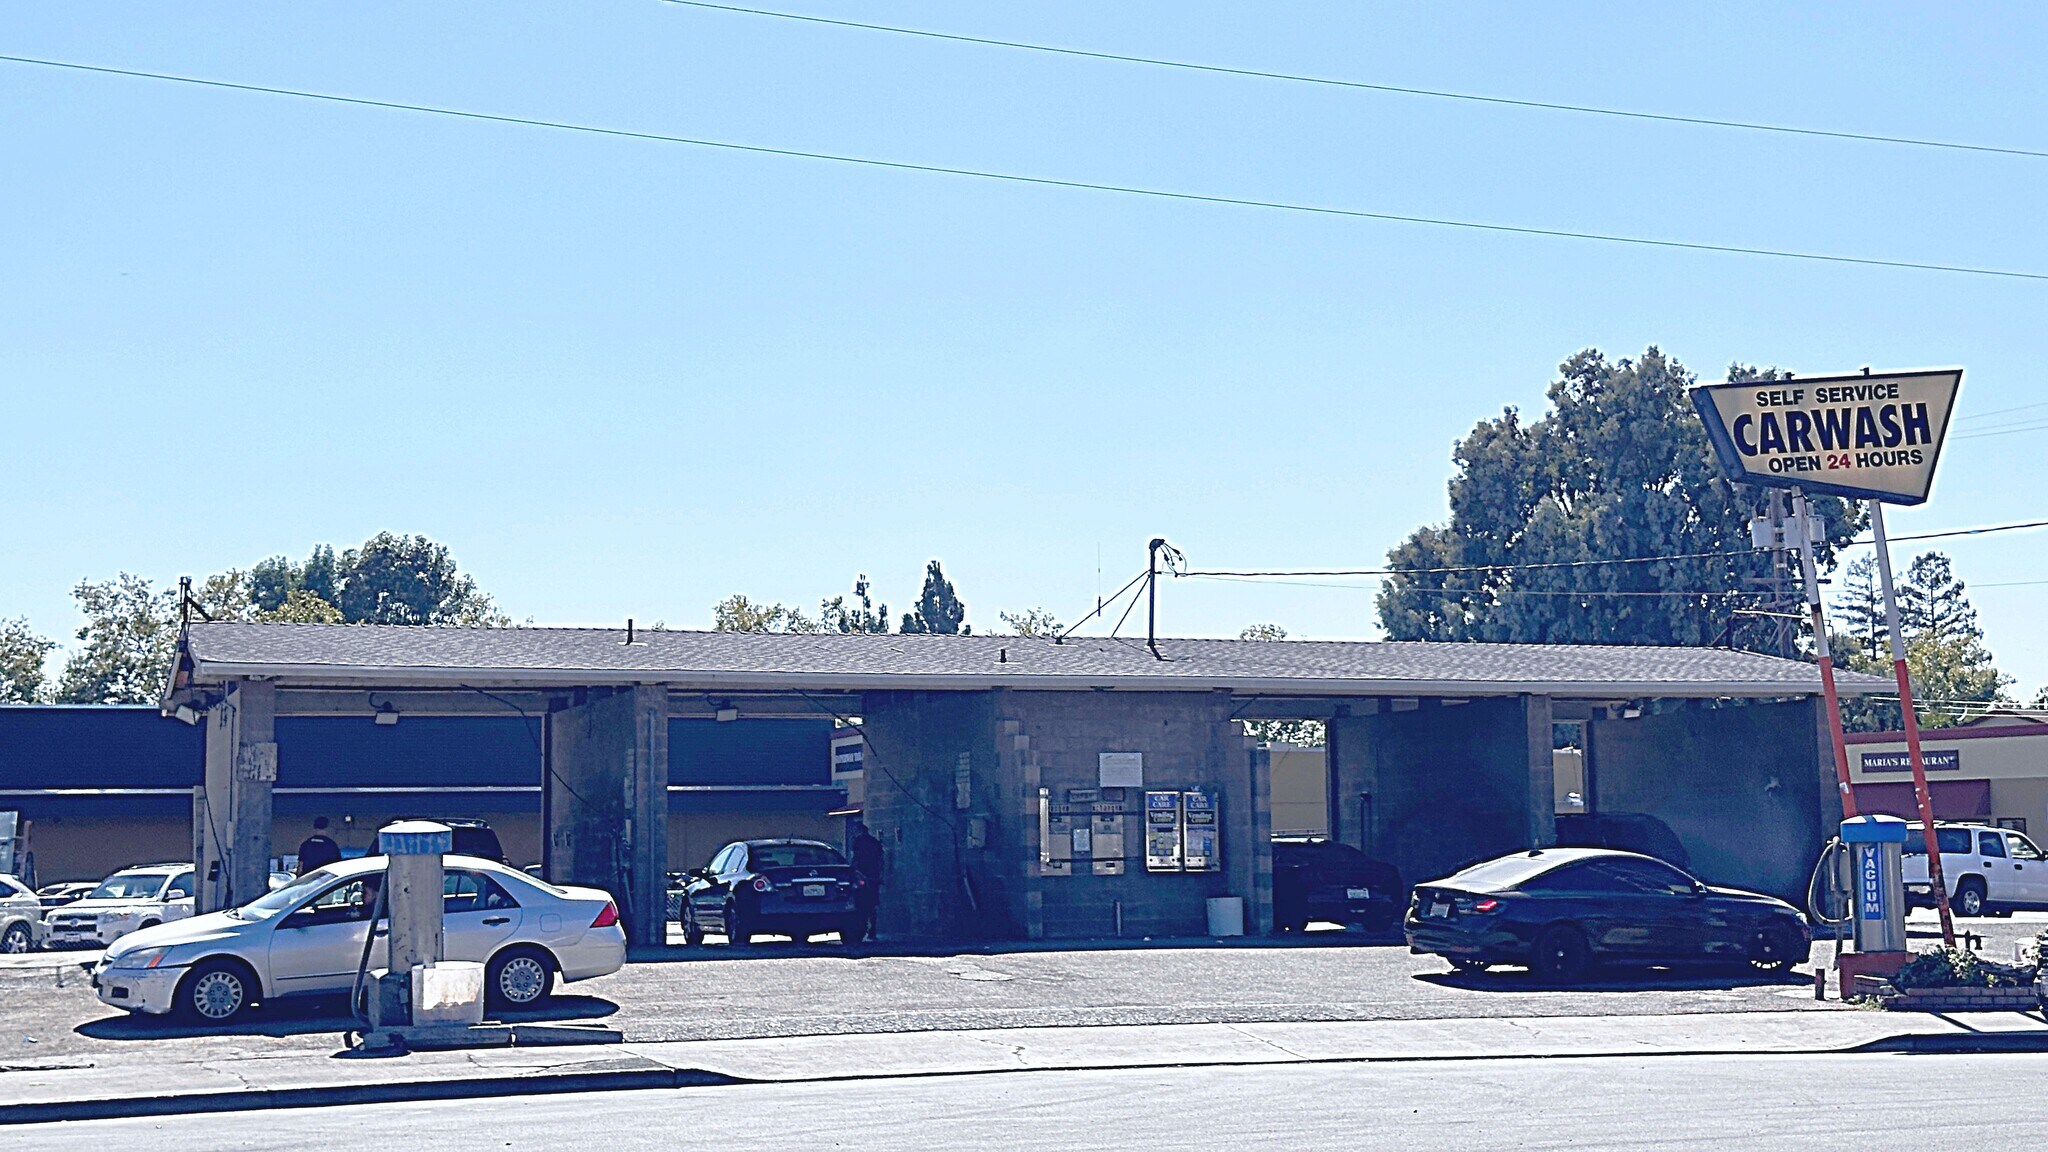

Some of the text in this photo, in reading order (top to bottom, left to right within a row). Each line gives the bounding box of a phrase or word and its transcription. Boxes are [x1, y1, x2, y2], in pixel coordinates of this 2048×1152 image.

[1756, 383, 1899, 407] SELF SERVICE
[1733, 402, 1932, 457] CARWASH
[1768, 450, 1924, 474] OPEN 24 HOURS
[1864, 757, 1898, 768] MARIA'S
[1864, 848, 1879, 913] VACUUM
